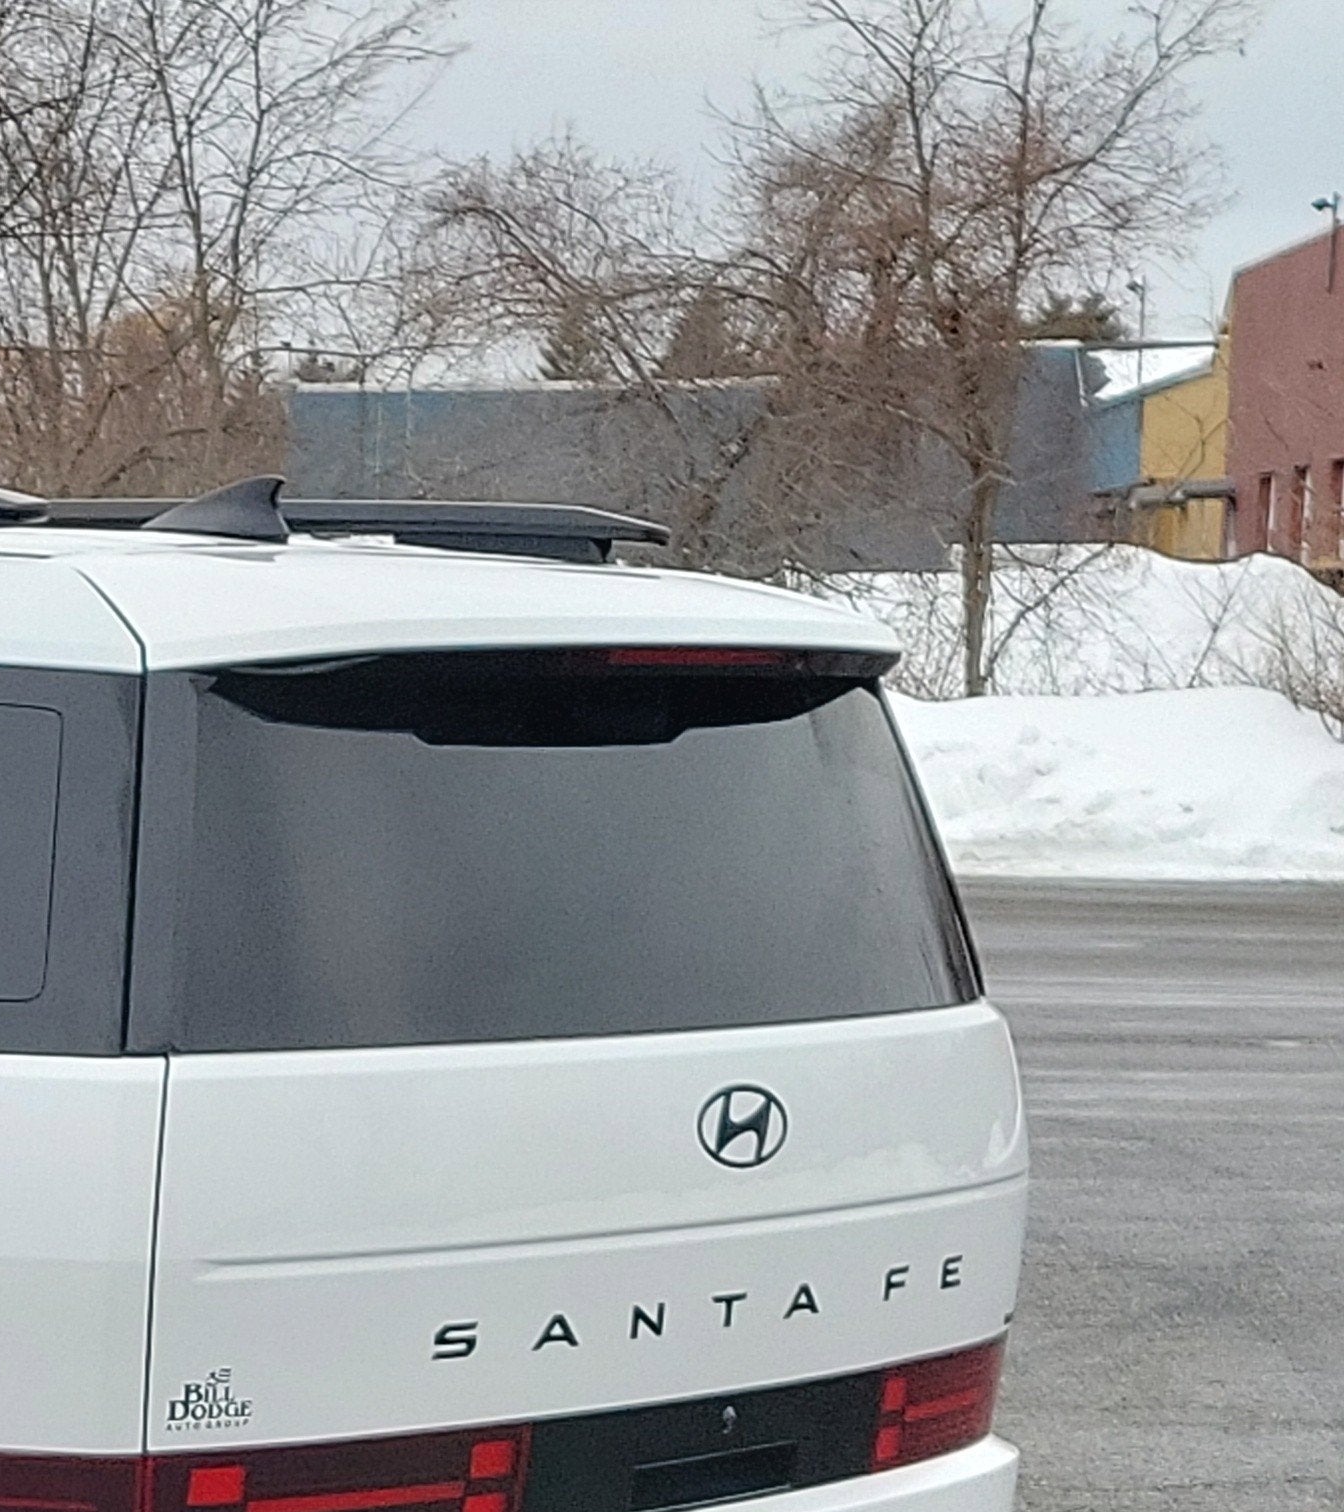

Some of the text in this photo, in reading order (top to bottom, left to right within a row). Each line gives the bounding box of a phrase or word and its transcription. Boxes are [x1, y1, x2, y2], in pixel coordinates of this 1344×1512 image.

[431, 1254, 964, 1361] SANTA FE
[184, 1383, 234, 1403] BILL
[166, 1400, 253, 1421] DODGE
